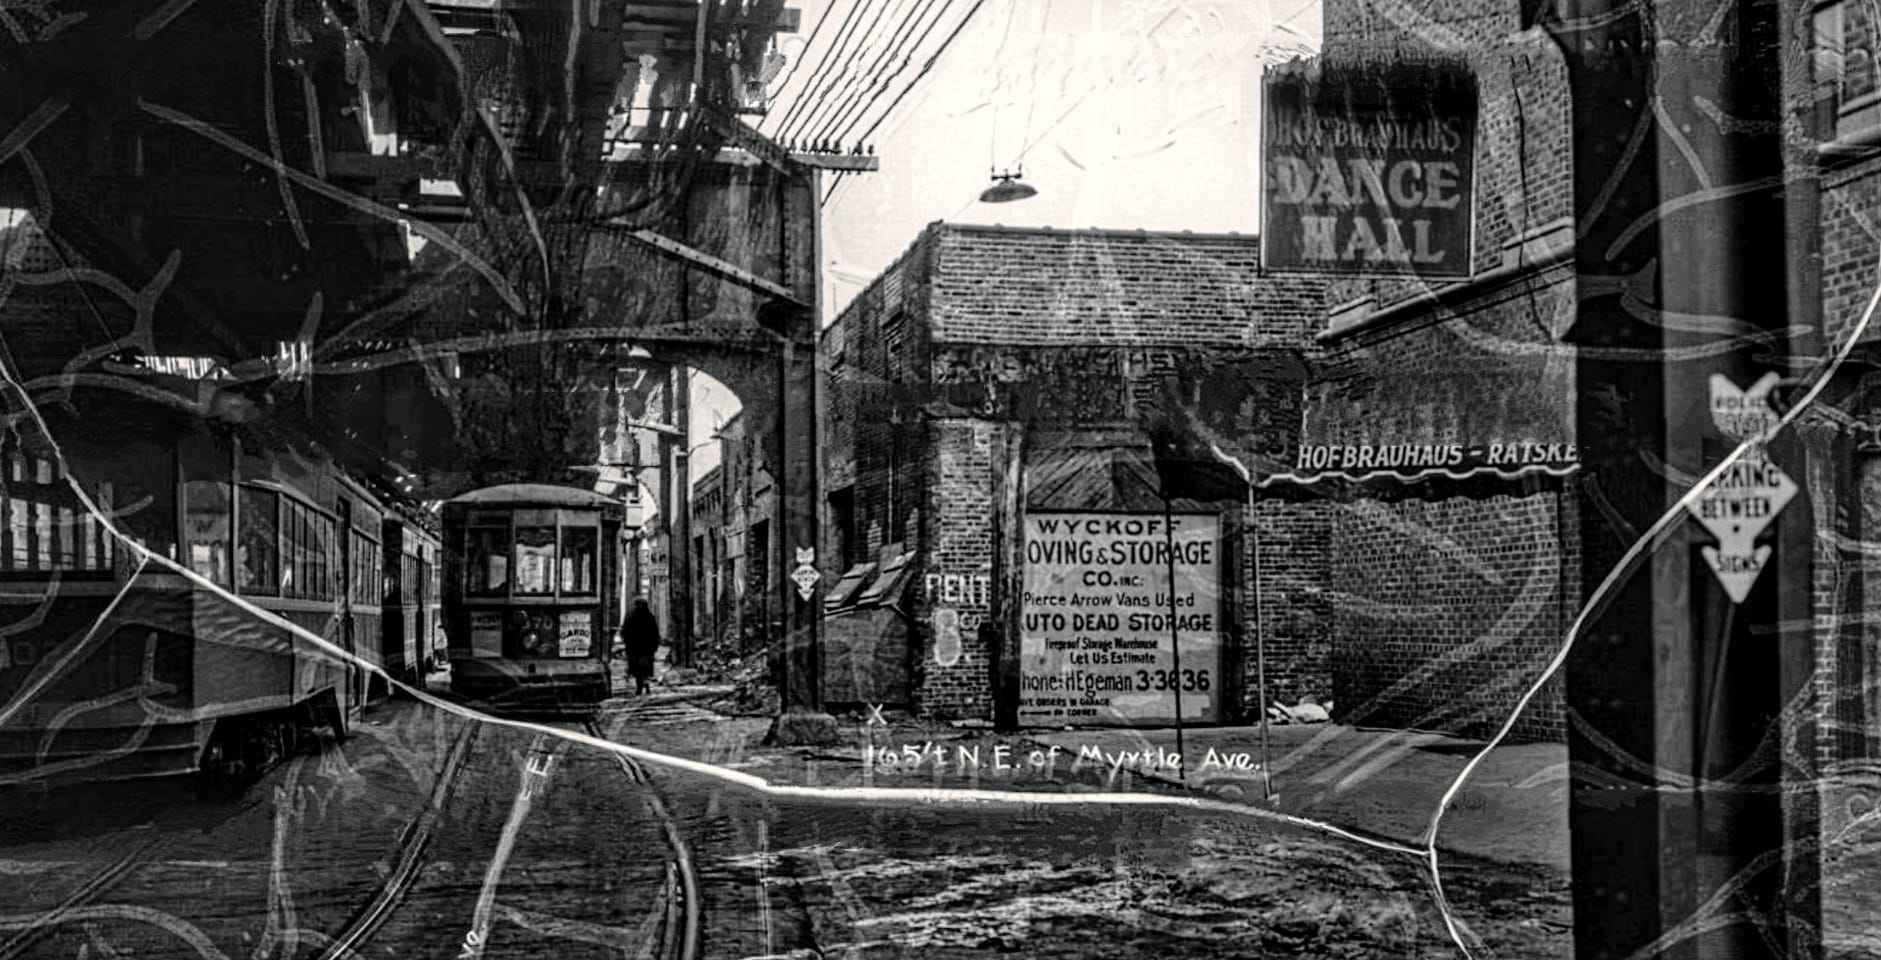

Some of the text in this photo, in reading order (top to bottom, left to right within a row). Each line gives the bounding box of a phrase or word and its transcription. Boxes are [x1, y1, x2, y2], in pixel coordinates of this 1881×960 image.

[1273, 156, 1461, 209] DANCE
[1301, 216, 1445, 263] HALL
[1297, 445, 1464, 469] HOFBRAUHAUS
[1701, 498, 1770, 518] BETWEEN
[1038, 519, 1181, 535] WYCKOFF
[1717, 556, 1760, 572] SIGNS
[1082, 571, 1118, 587] CO.
[1024, 592, 1195, 606] Pierce Arrow Vans Used
[1022, 614, 1212, 631] UTO DEAD STORAGE
[1082, 637, 1113, 653] Storage
[1114, 637, 1158, 650] Warehouse
[1070, 652, 1156, 665] Let Us Estimate
